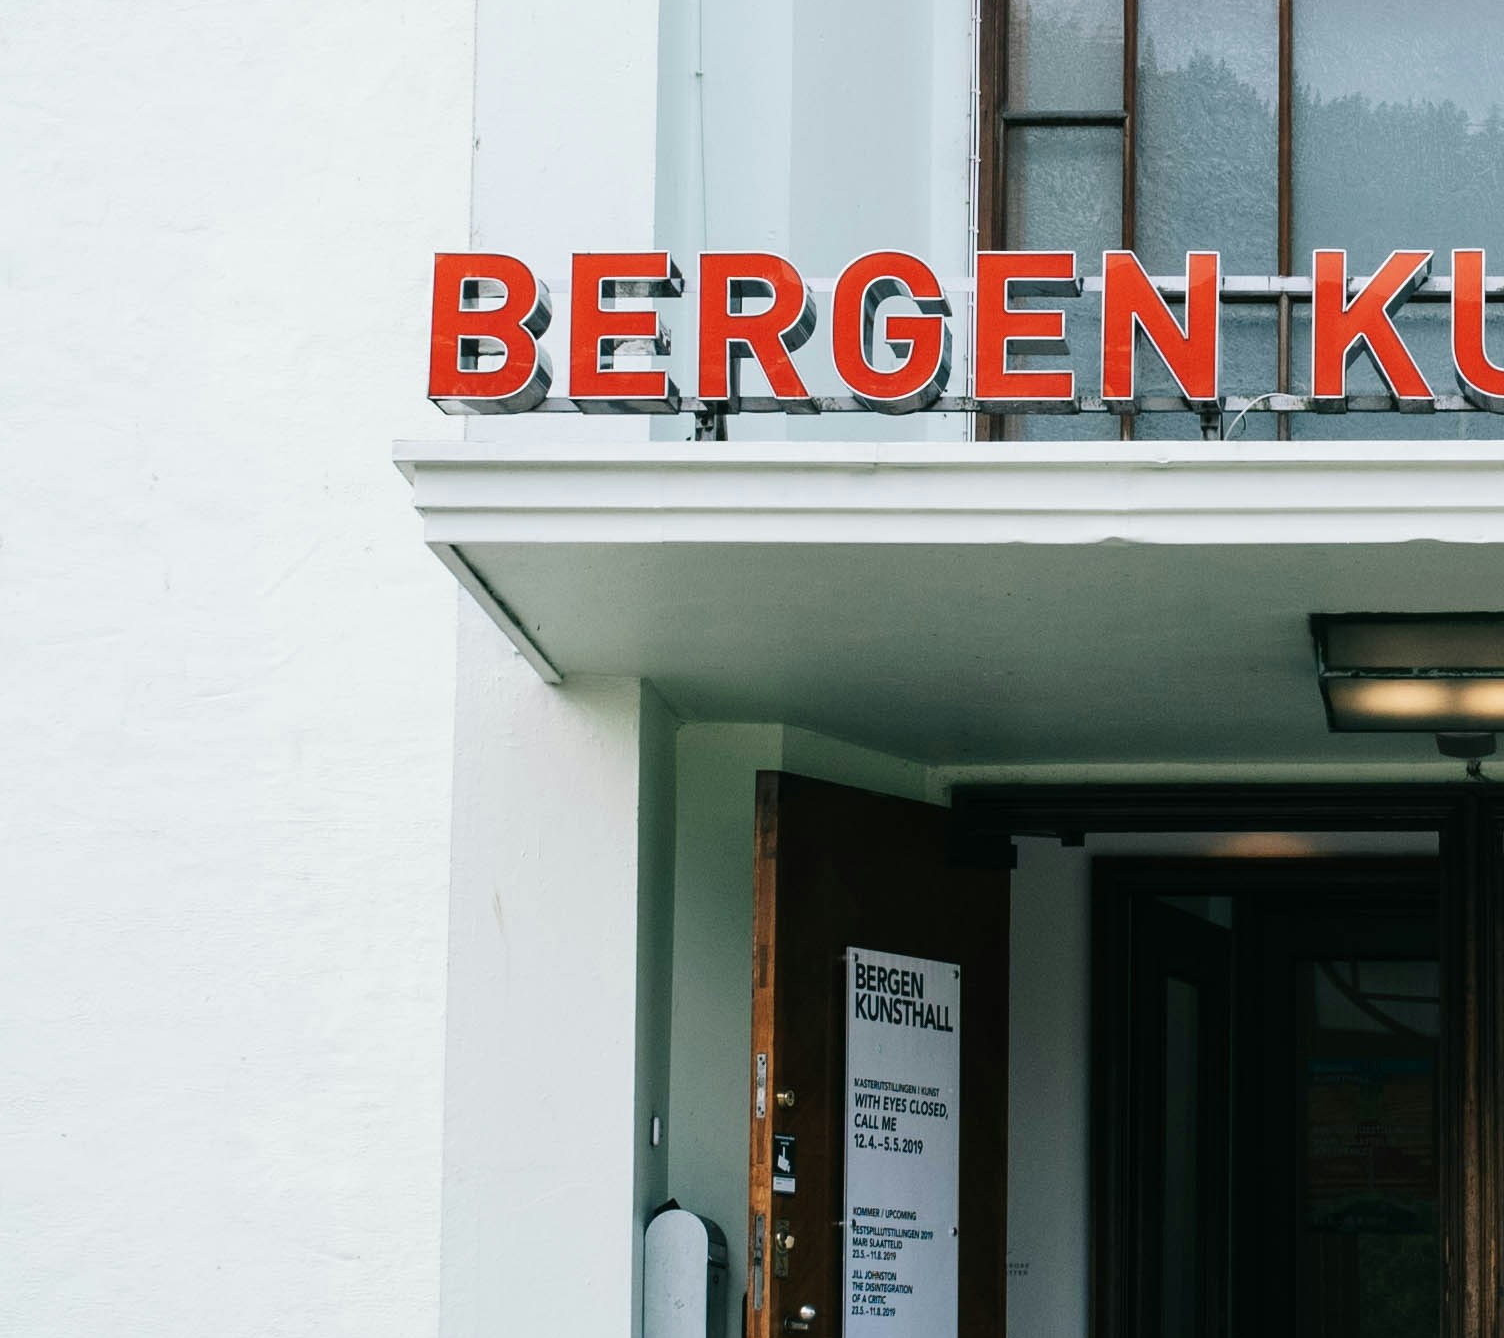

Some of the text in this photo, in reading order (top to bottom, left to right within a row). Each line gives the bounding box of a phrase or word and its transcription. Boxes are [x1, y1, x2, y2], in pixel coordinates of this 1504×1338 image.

[426, 249, 1219, 402] BERGEN
[855, 963, 924, 999] BERGEN
[855, 992, 954, 1032] KUNSTHALL
[854, 1092, 949, 1120] WITH EYES CLOSED,
[854, 1113, 897, 1131] CALL ME
[885, 1209, 917, 1221] UPCOMING
[852, 1237, 868, 1247] MARI
[852, 1281, 914, 1294] THE DISINTEGRATION
